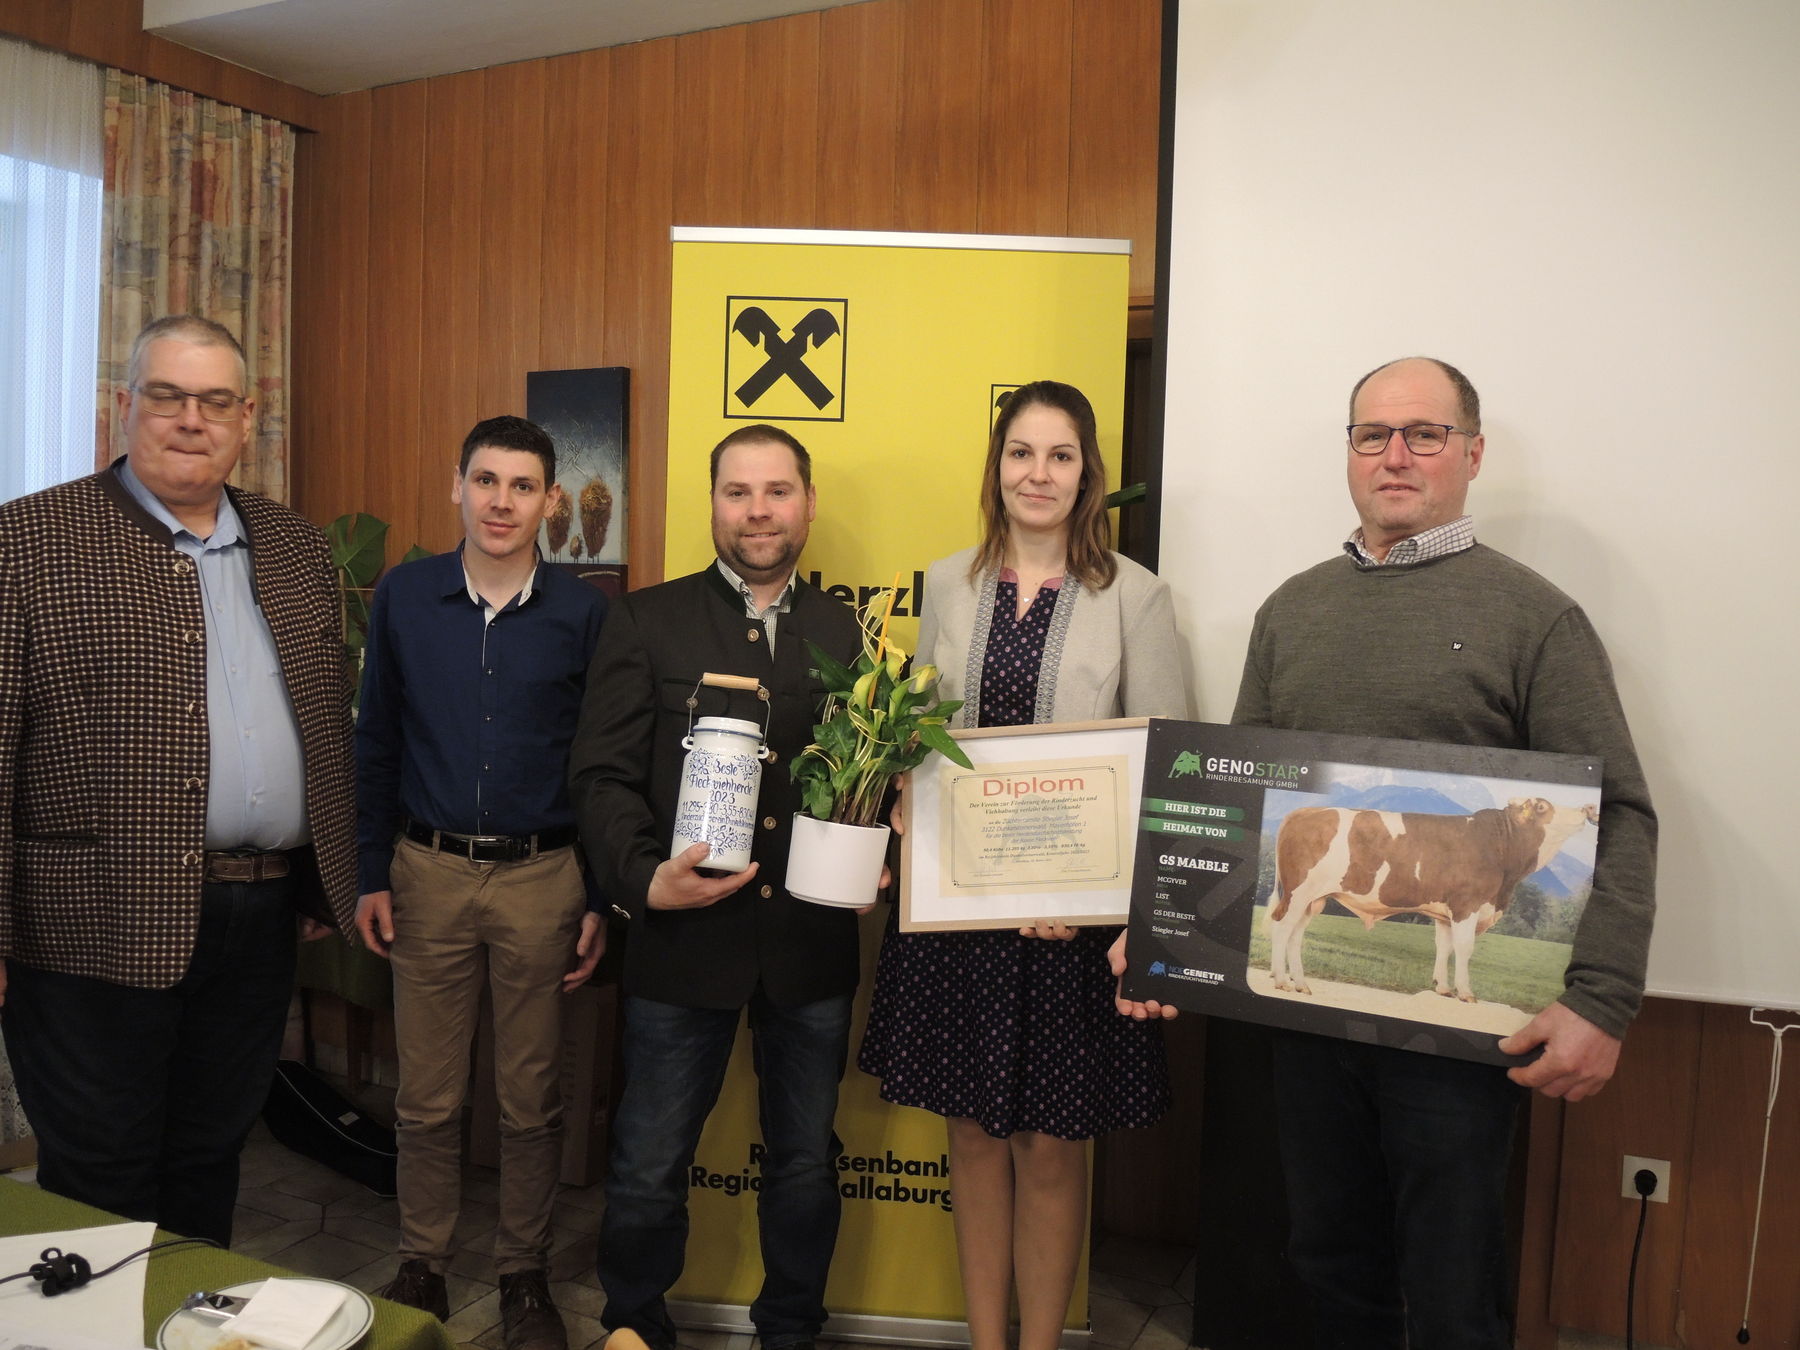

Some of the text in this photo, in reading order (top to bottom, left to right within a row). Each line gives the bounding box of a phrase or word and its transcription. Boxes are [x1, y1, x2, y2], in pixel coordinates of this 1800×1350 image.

[713, 759, 738, 776] Beste
[983, 776, 1084, 798] Diplom
[1205, 773, 1299, 789] RINDERBESAMUNG GMBH
[710, 789, 736, 804] 2023
[1165, 802, 1227, 818] HIER IST DIE
[1162, 822, 1228, 838] HEIMAT VON
[1159, 854, 1230, 873] GS MARBLE
[1157, 875, 1187, 886] MCGYVER
[1155, 892, 1170, 900] LIST
[1153, 909, 1163, 917] GS
[1163, 910, 1176, 919] DER
[1176, 912, 1196, 921] BESTE
[1151, 925, 1174, 935] Stiegler
[1174, 928, 1190, 937] Josef
